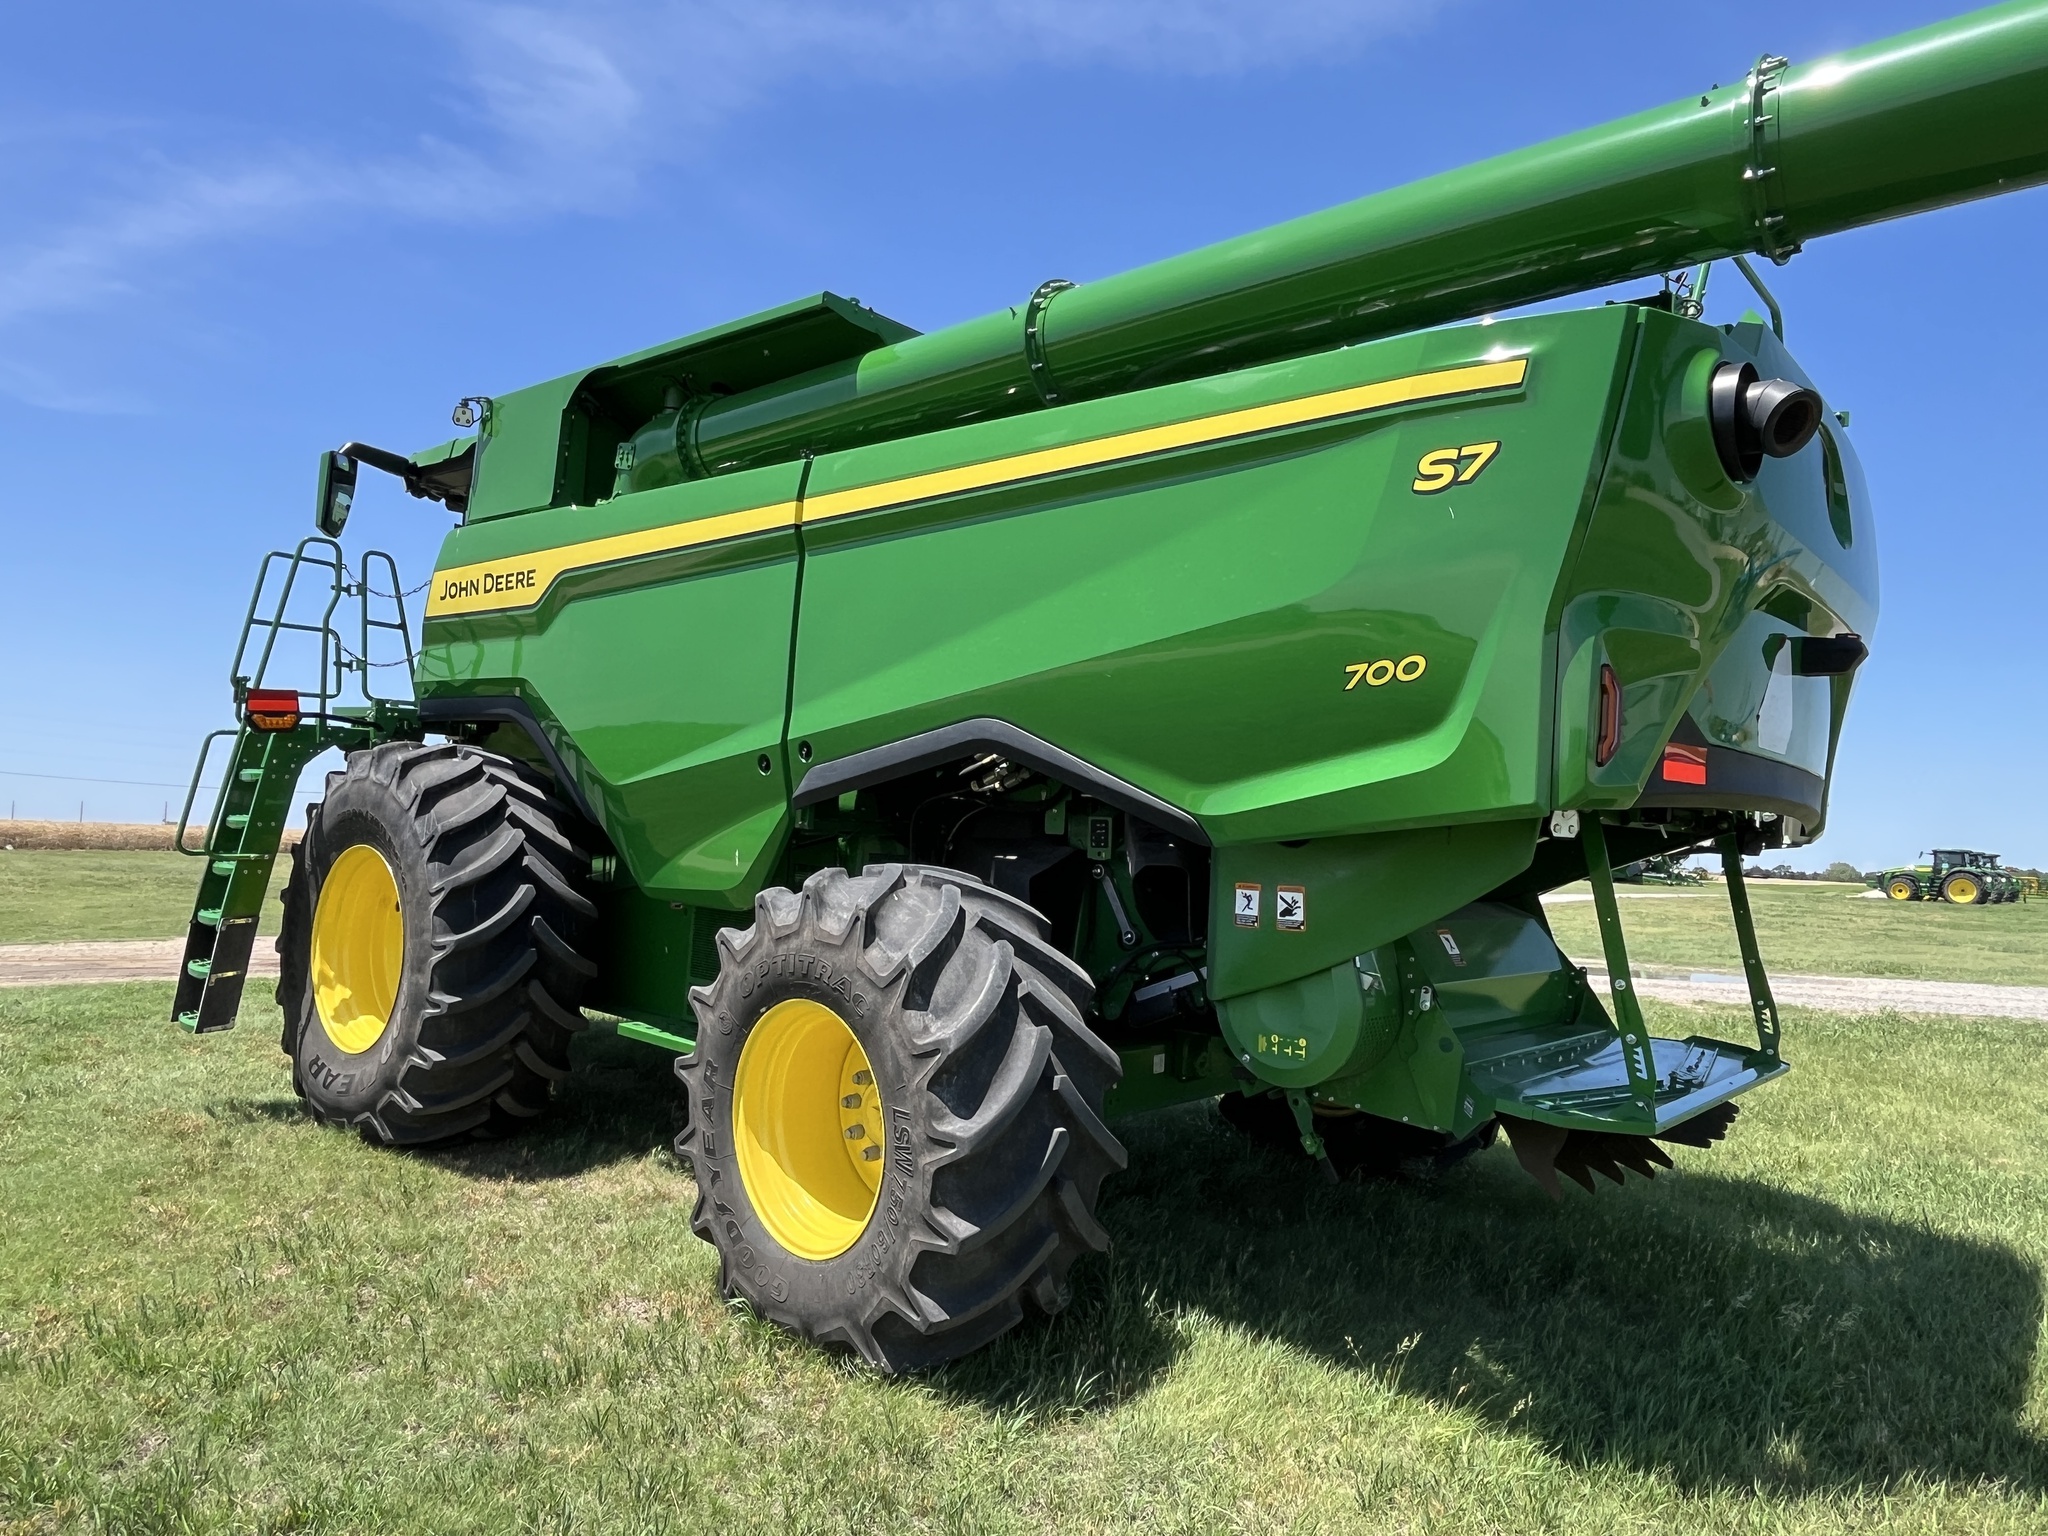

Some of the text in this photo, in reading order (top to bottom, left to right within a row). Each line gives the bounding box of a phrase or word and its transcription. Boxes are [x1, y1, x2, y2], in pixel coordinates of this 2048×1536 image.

[1411, 440, 1503, 496] S7
[439, 569, 536, 601] JOHN DEERE
[1342, 653, 1428, 692] 700
[740, 952, 871, 1019] OPTITRAC
[891, 1105, 914, 1178] LSW
